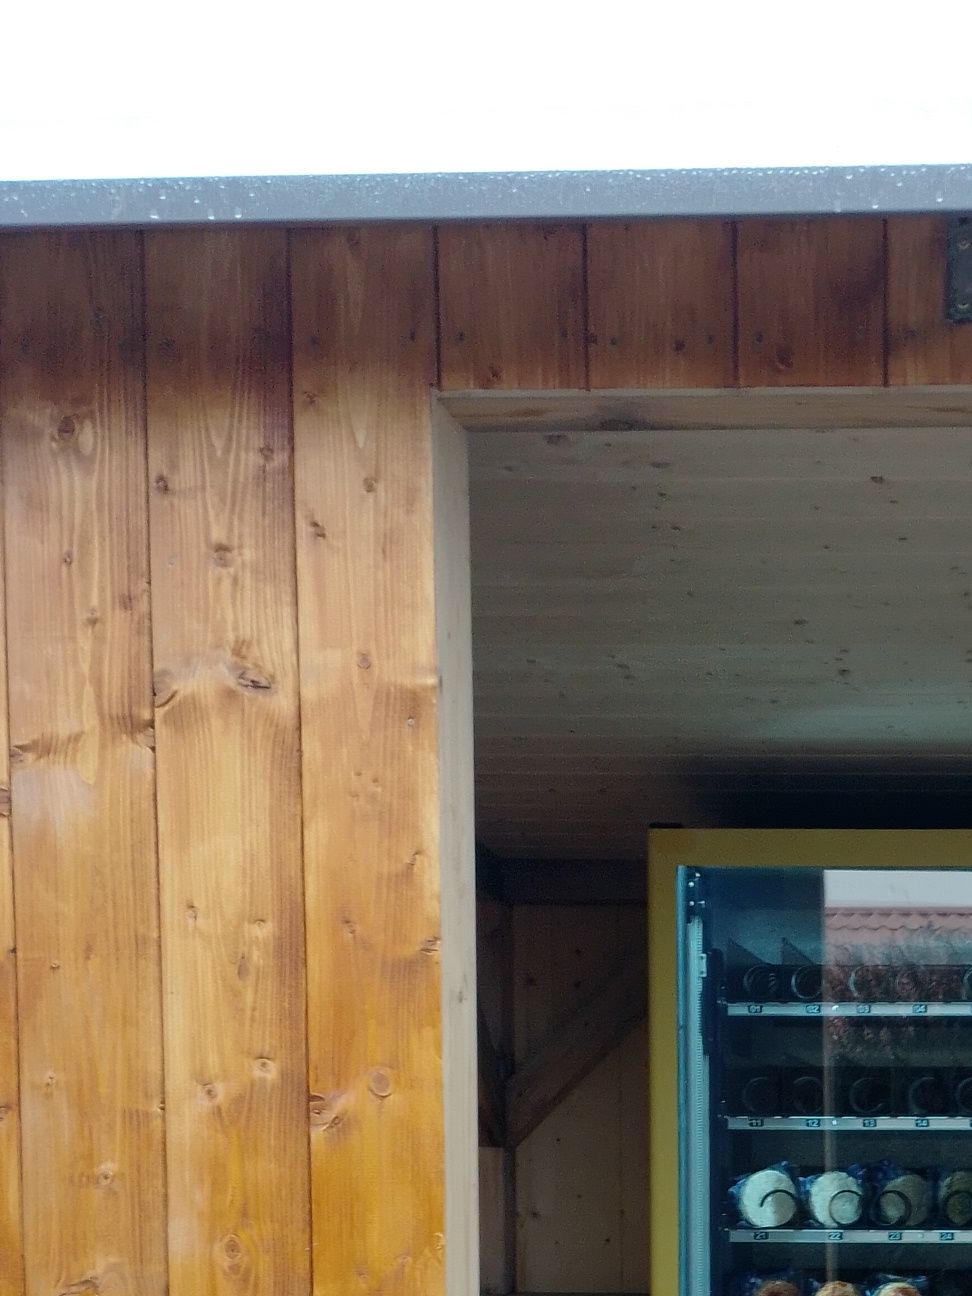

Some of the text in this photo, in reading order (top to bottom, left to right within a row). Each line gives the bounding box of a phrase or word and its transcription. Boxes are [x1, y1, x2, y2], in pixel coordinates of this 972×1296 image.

[749, 1005, 762, 1013] 01
[807, 1005, 820, 1013] 02
[750, 1119, 763, 1127] 11
[807, 1119, 819, 1127] 12
[864, 1119, 875, 1127] 13
[830, 1232, 842, 1240] 22
